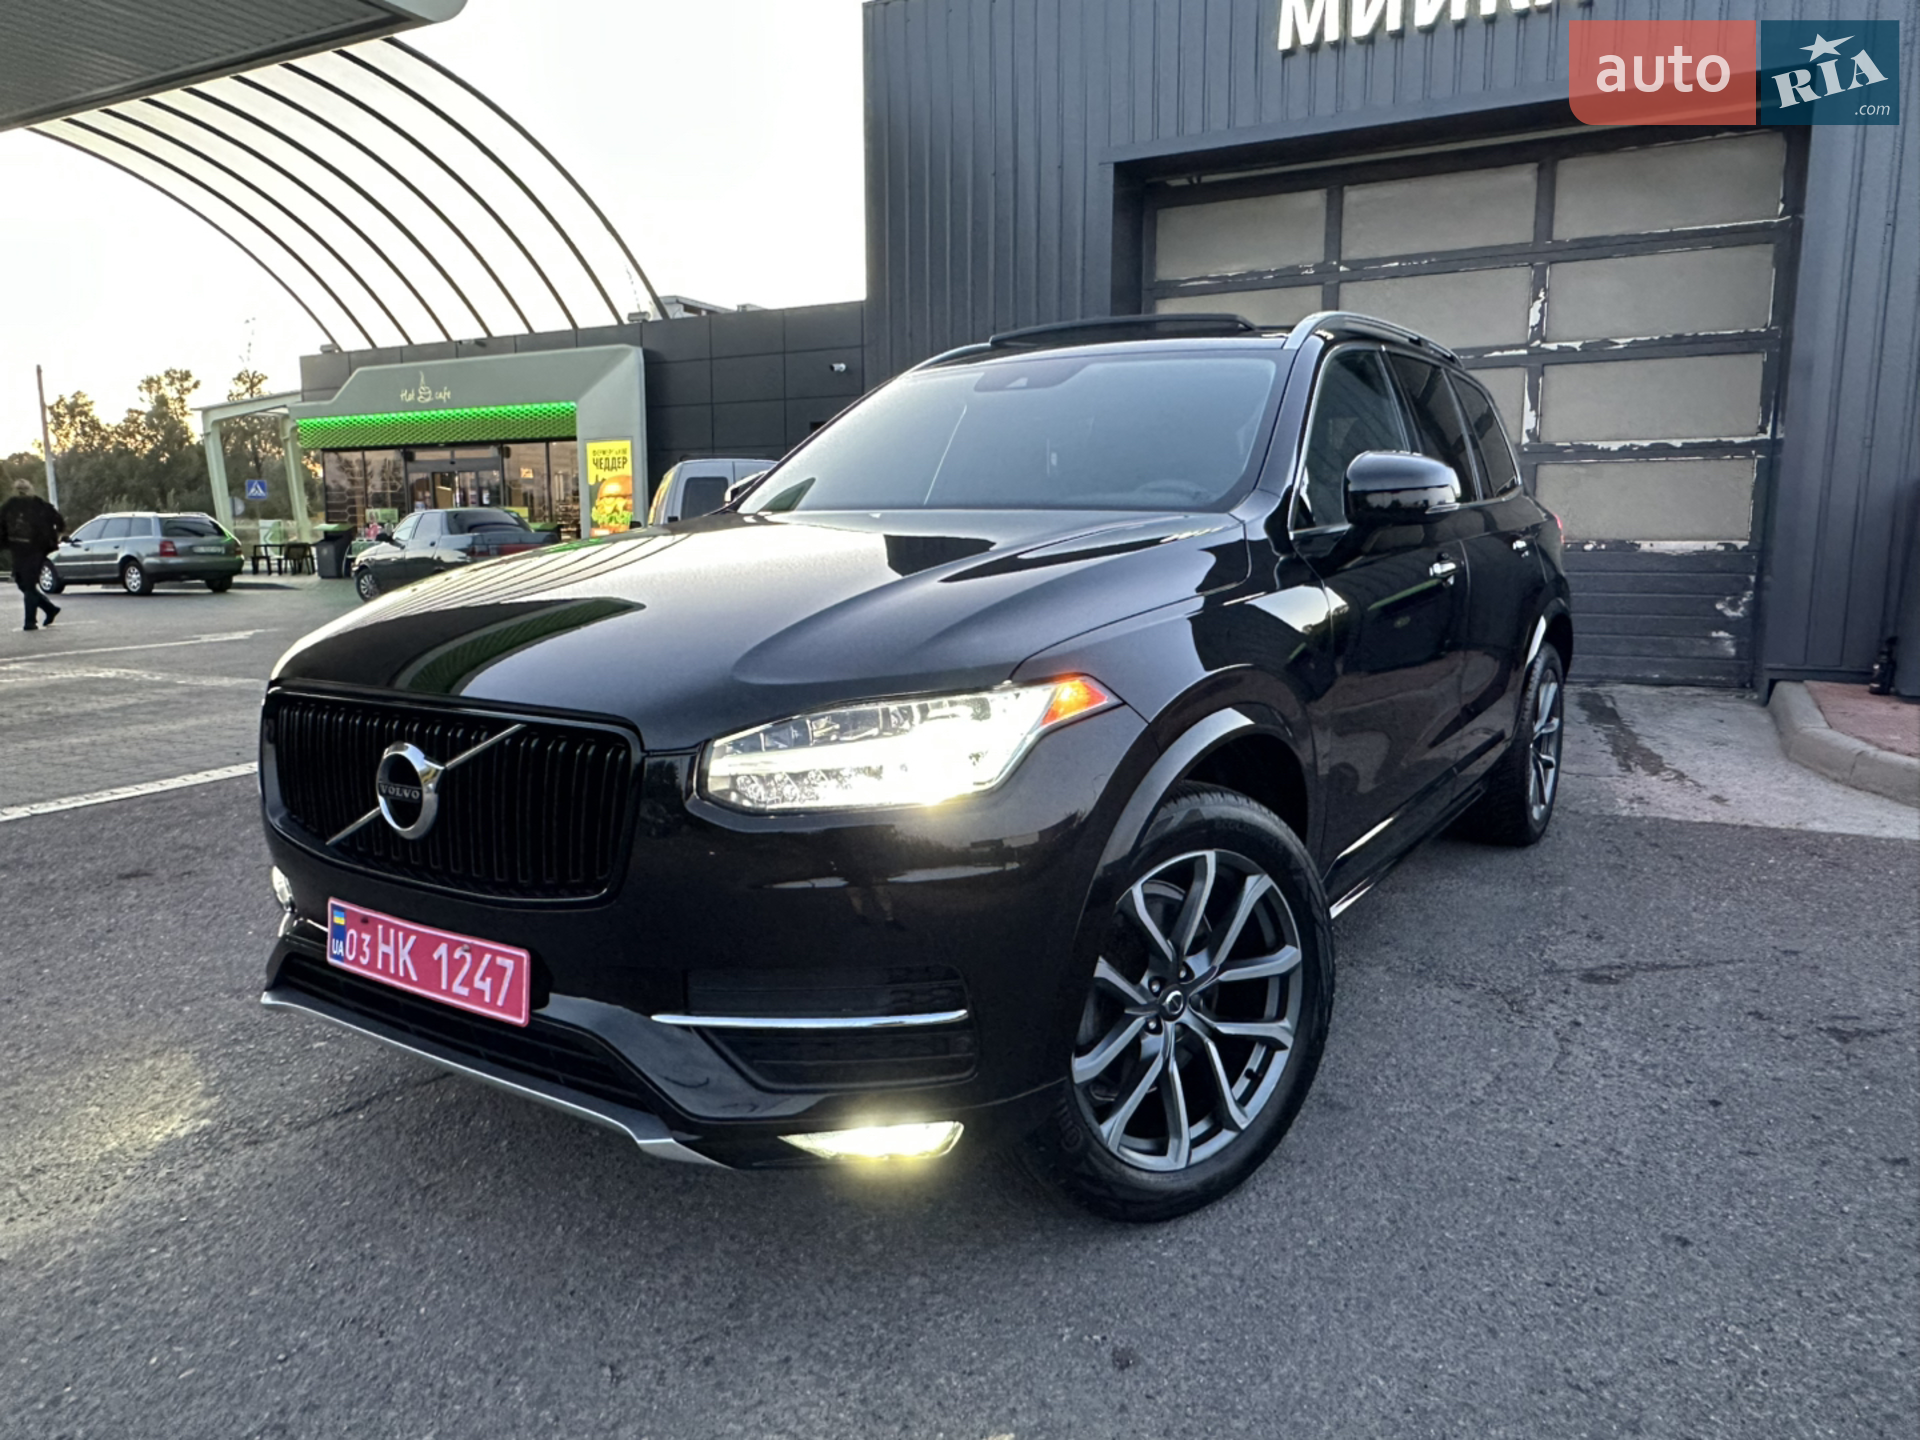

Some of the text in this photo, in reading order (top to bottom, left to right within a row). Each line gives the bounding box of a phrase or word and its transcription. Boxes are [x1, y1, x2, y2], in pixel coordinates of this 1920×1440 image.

[592, 456, 628, 472] ЧЕДДЕР
[379, 784, 420, 800] VOLVO
[331, 938, 345, 957] UA
[432, 942, 515, 1008] 1247
